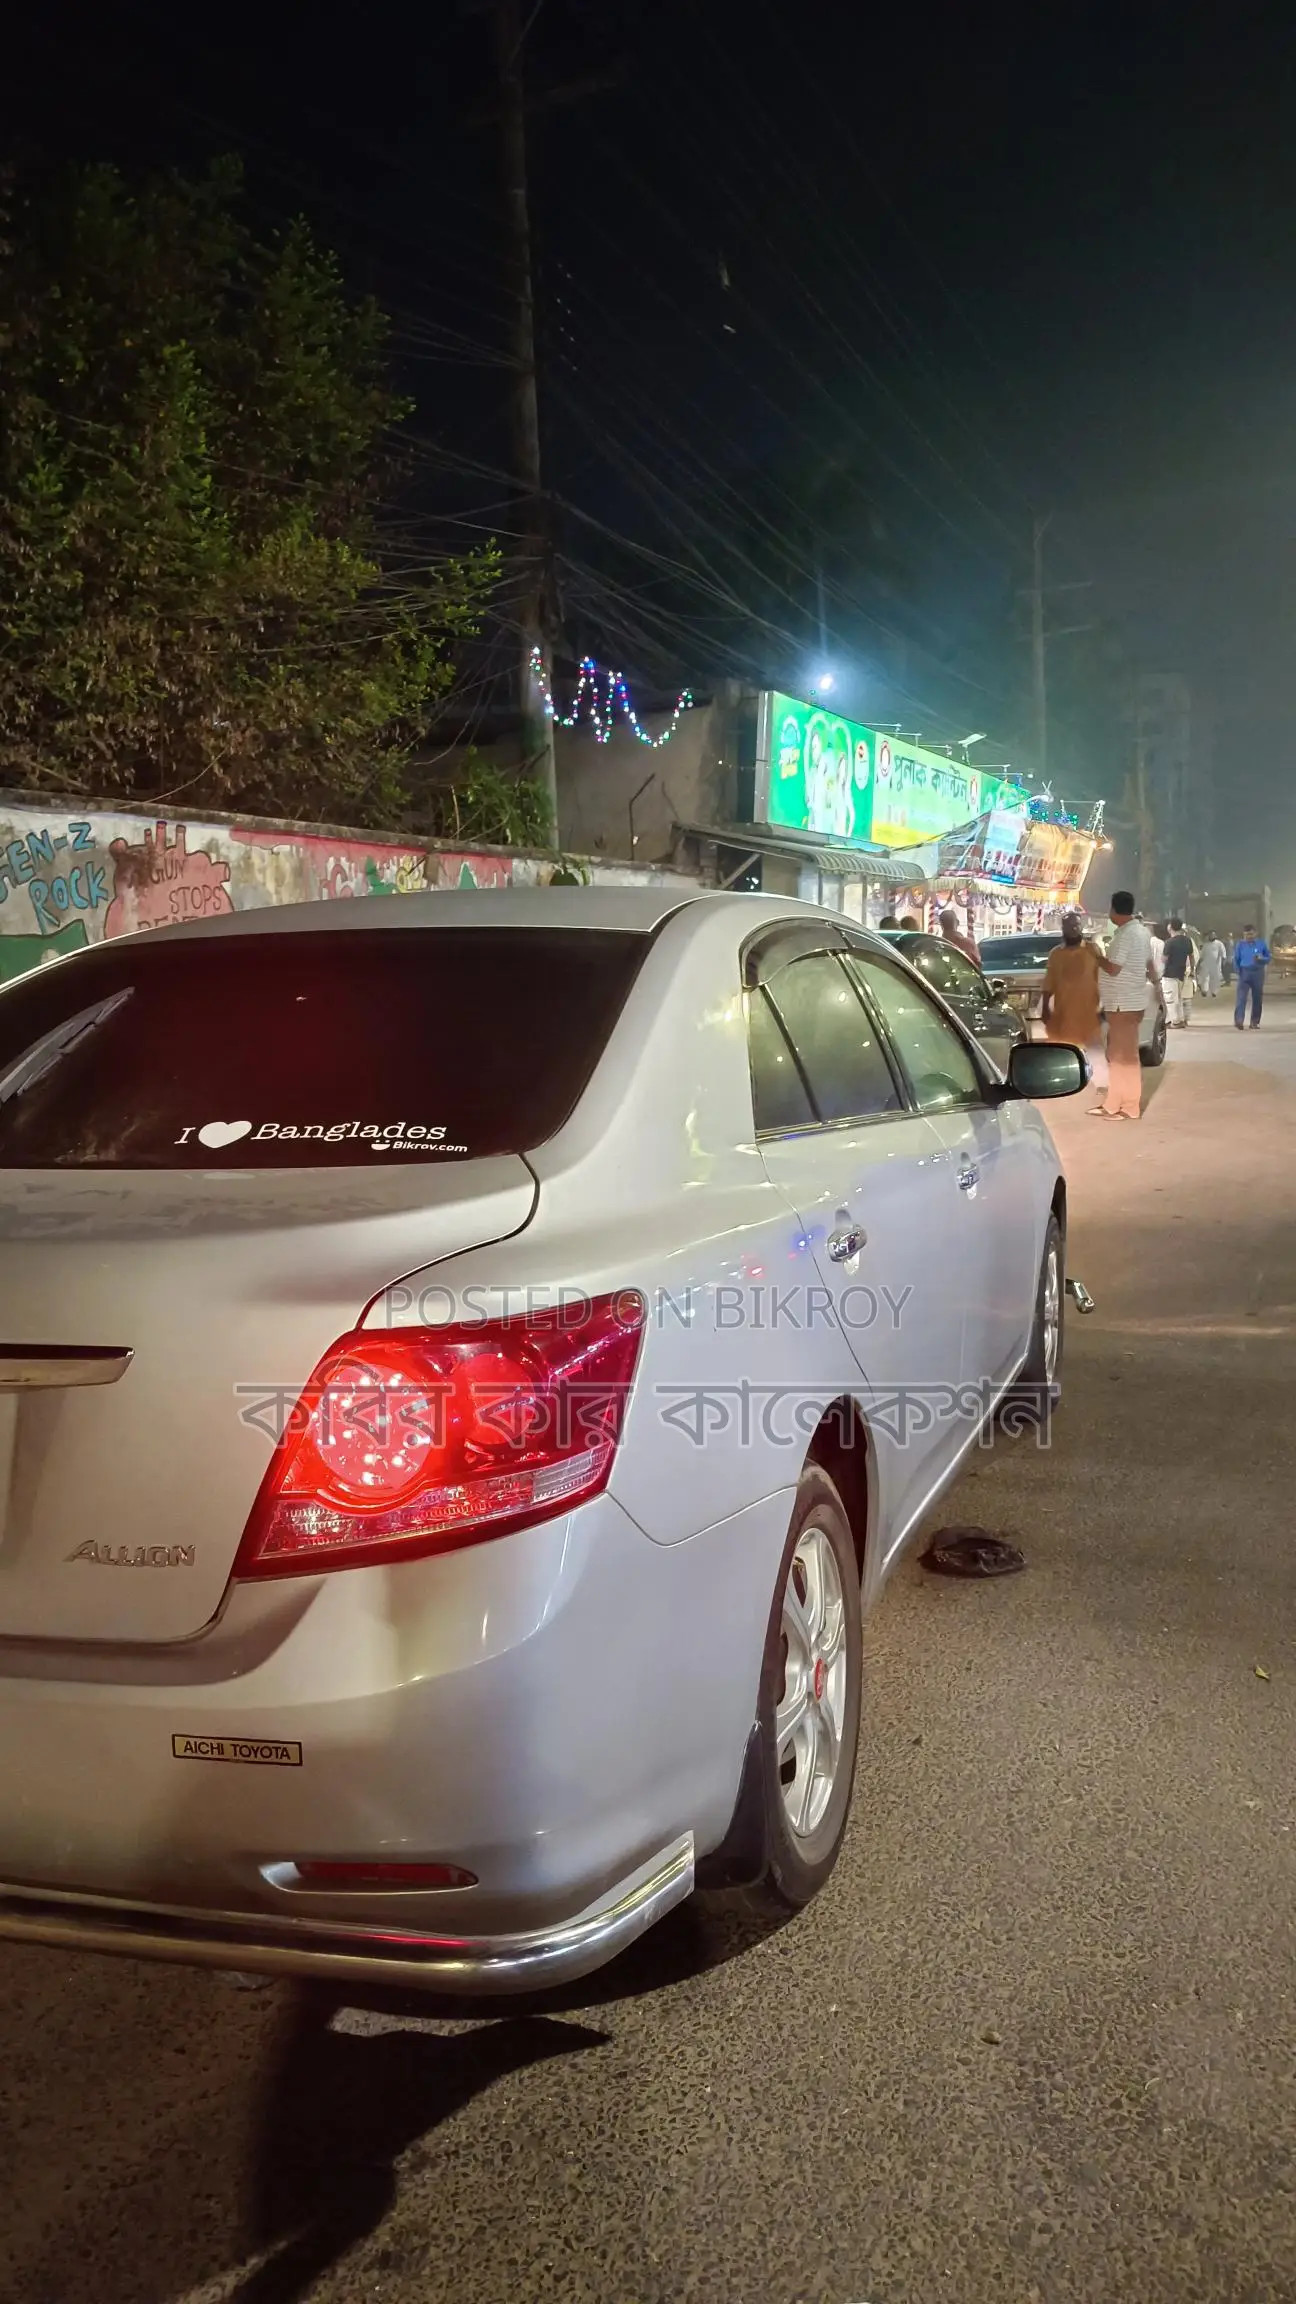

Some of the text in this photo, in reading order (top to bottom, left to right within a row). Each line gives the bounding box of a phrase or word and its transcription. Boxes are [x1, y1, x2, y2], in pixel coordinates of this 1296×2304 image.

[151, 857, 188, 885] GUN
[28, 860, 108, 935] ROCK
[169, 884, 222, 915] STOPS
[174, 1121, 448, 1145] I Banglades
[62, 1540, 196, 1567] ALLION
[183, 1740, 291, 1760] AICHI TOYOTA
